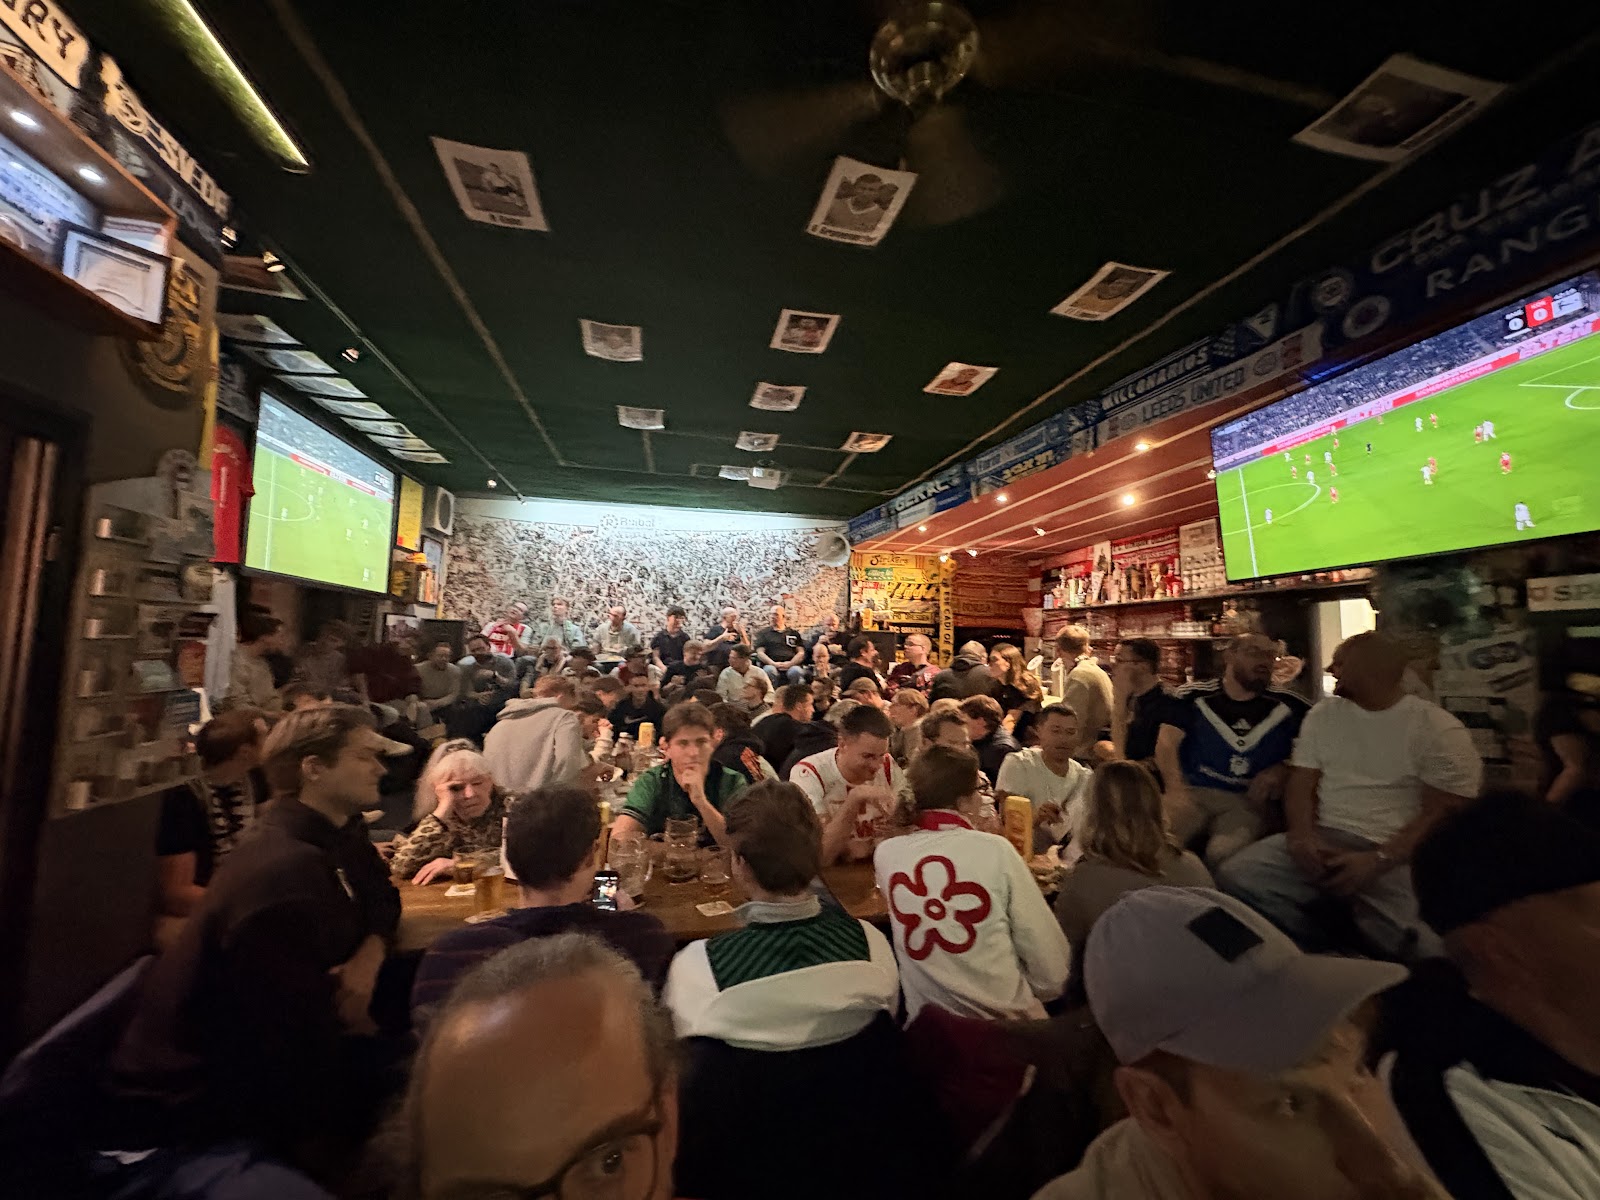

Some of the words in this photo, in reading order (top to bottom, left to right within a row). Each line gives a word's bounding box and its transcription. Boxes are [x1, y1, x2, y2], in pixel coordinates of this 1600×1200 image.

[1370, 163, 1542, 275] CRUZ
[1426, 198, 1600, 299] RANG
[1143, 393, 1185, 424] LEEDS
